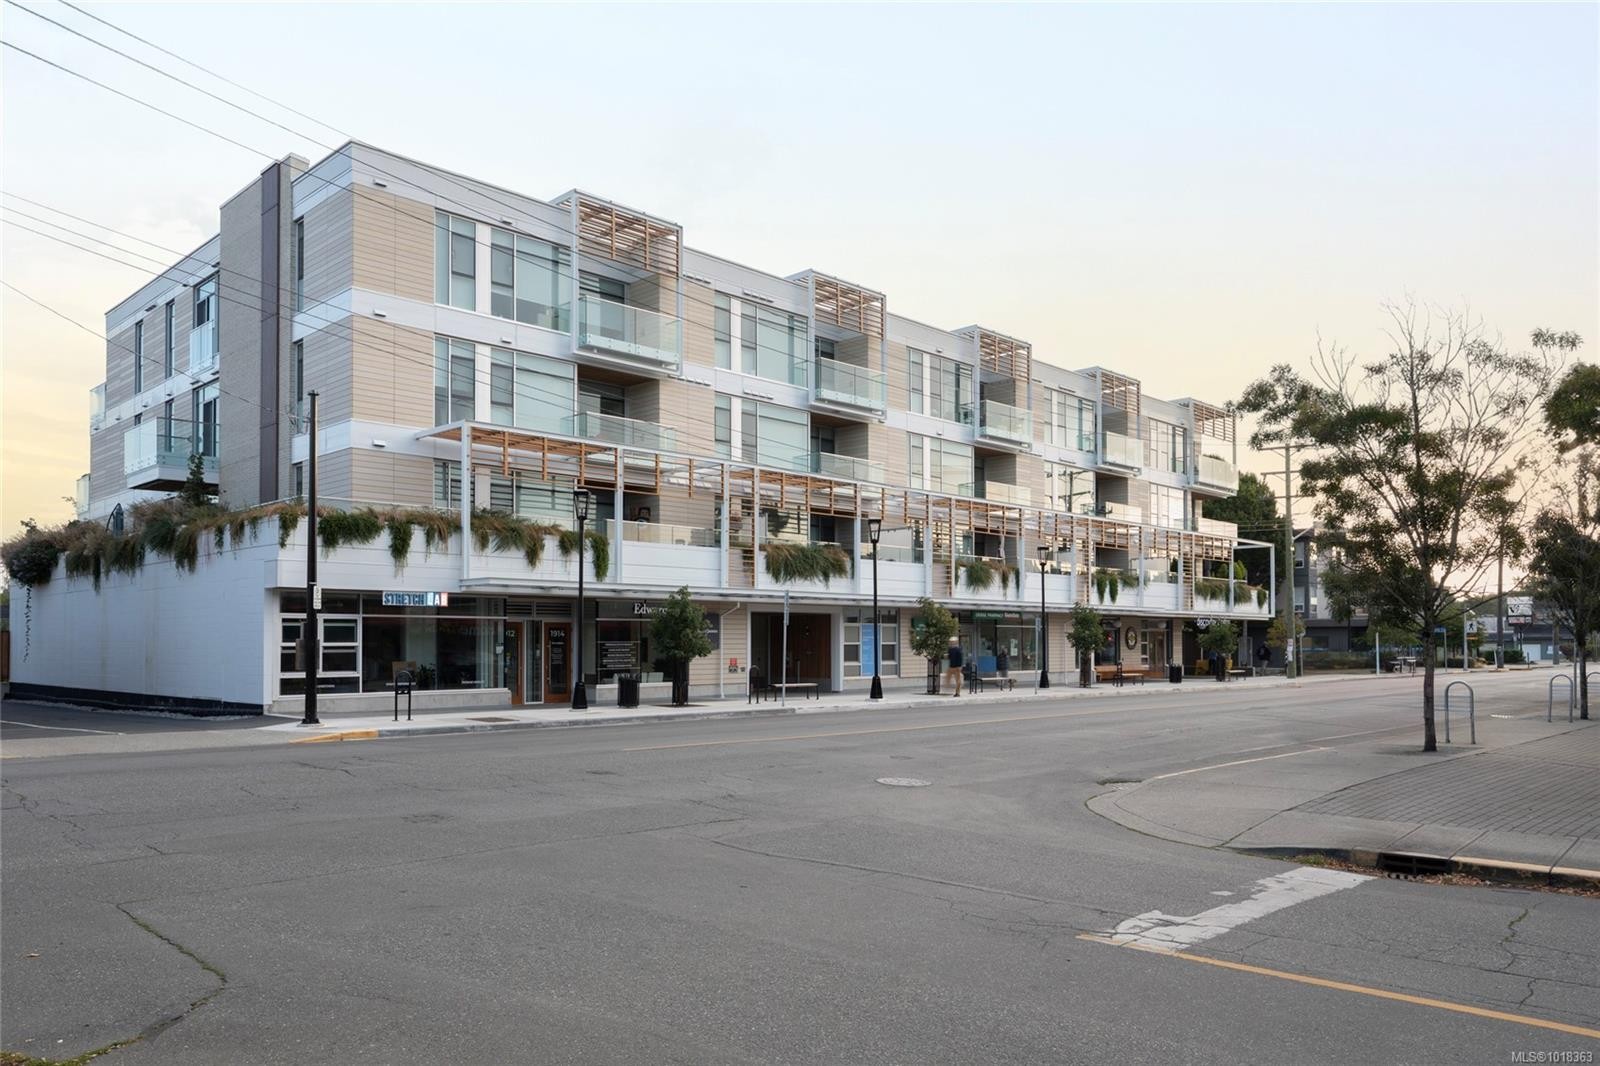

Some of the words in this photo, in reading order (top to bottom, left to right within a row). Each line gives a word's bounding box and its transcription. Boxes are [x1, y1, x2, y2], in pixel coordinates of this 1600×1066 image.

[384, 592, 424, 604] STRETCH
[427, 592, 448, 605] LAB
[550, 630, 566, 638] 1914
